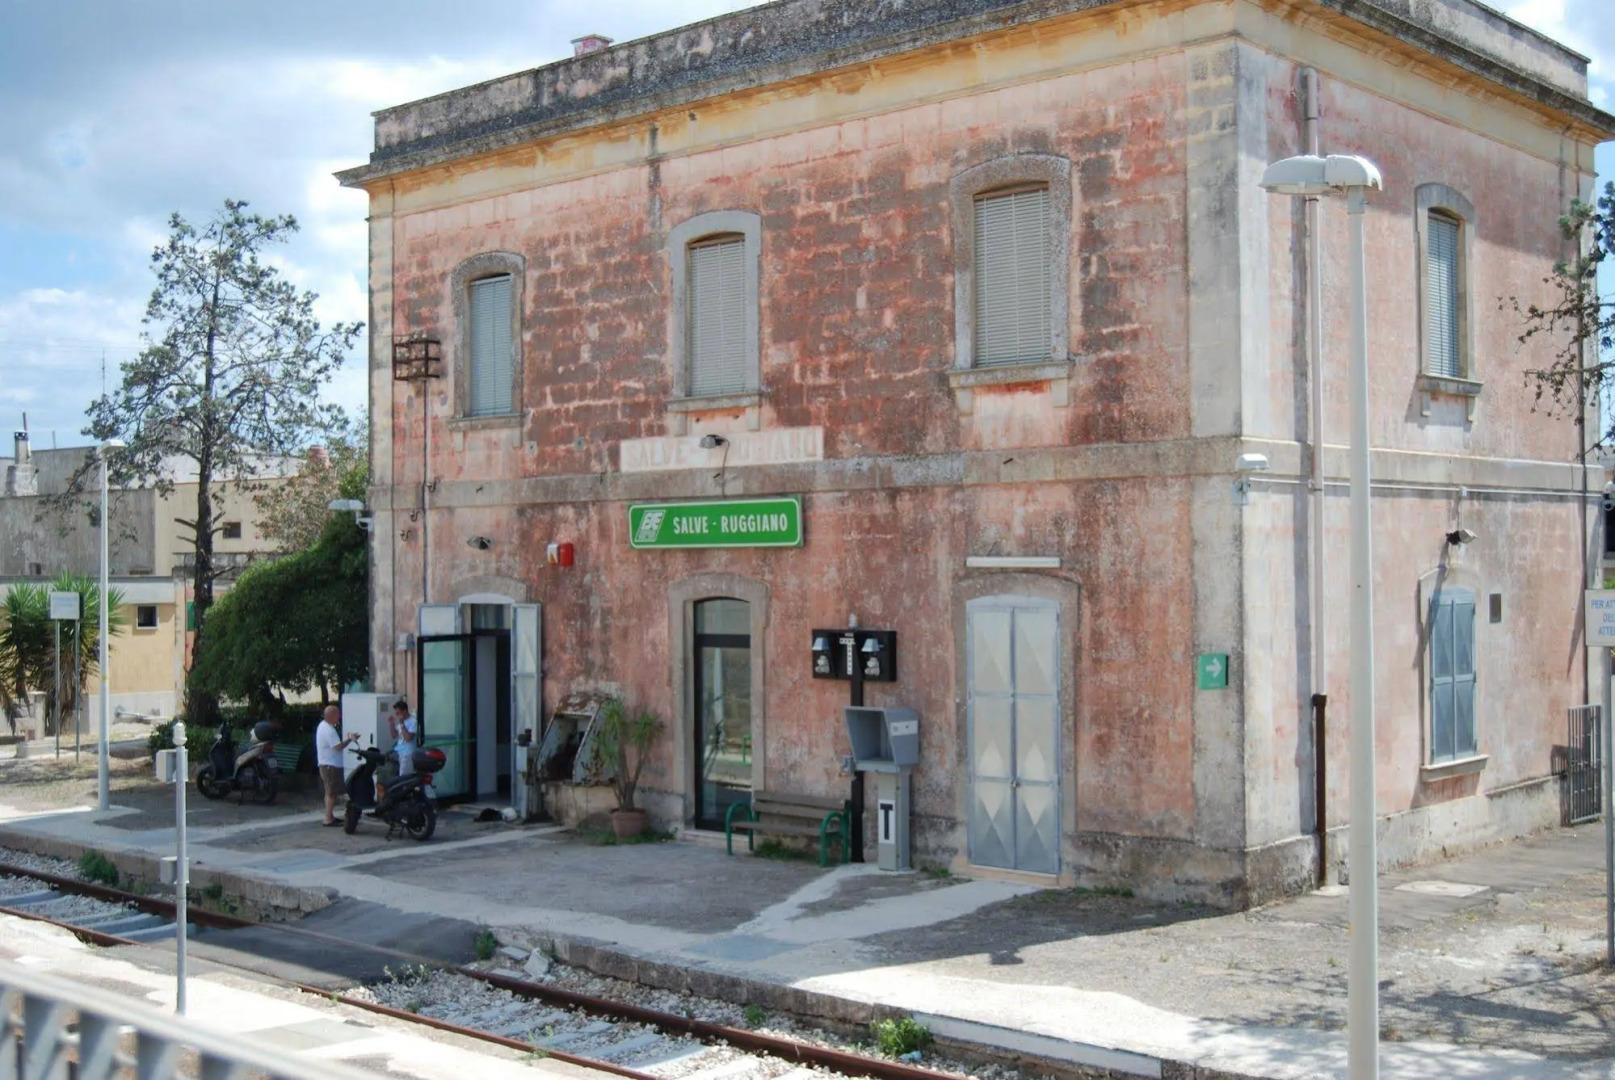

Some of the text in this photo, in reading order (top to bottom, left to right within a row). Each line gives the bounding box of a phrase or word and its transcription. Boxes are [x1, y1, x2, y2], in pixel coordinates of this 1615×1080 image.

[673, 516, 709, 534] SALVE
[721, 513, 788, 533] RUGGIANO
[1591, 600, 1604, 609] PER
[880, 803, 893, 840] T
